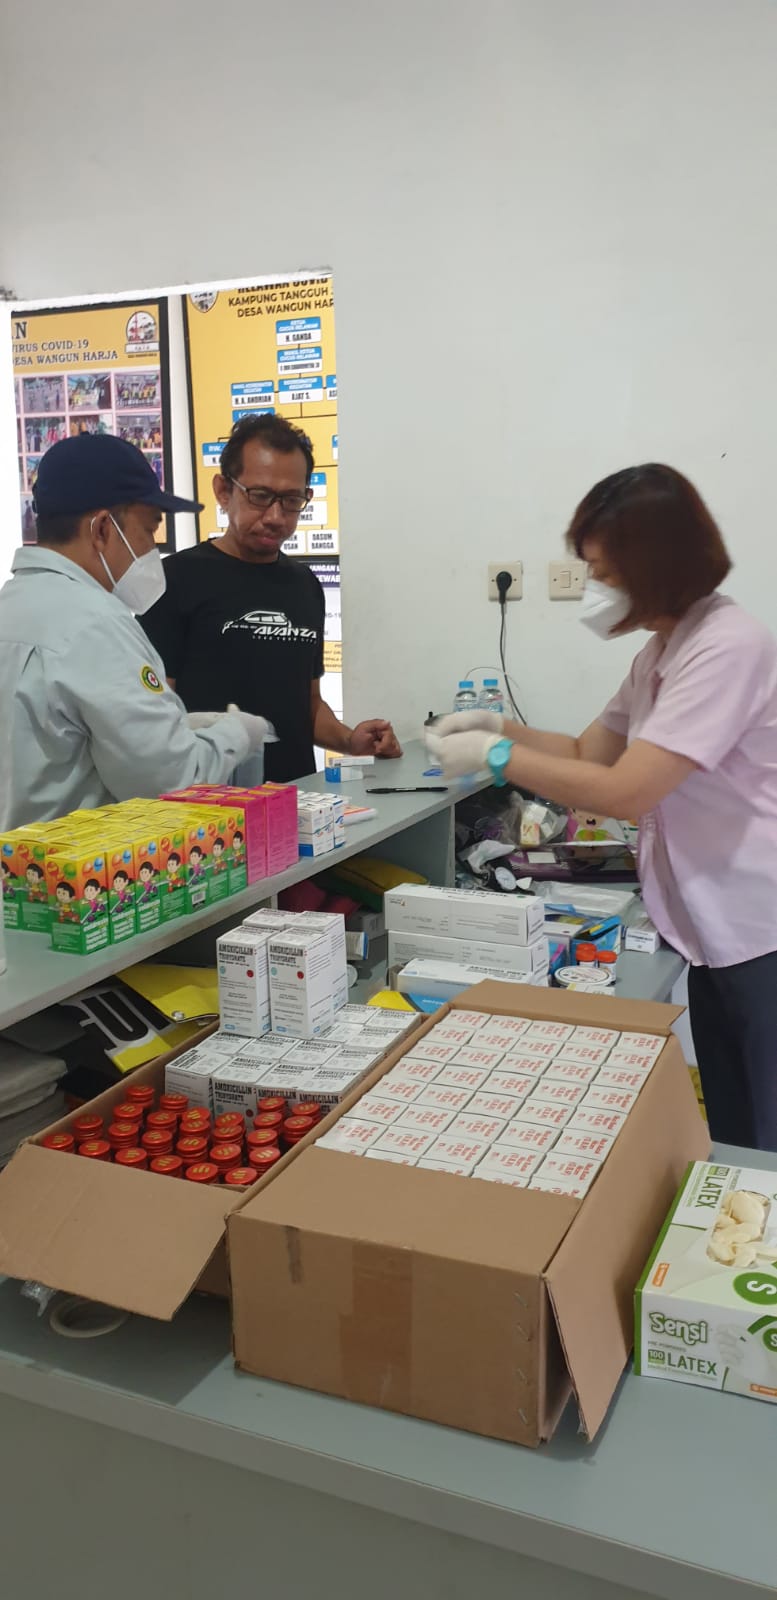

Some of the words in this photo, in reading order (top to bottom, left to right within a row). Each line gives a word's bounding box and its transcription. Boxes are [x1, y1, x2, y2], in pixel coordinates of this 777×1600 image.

[228, 292, 277, 307] KAMPUNG
[280, 286, 329, 301] TANGGUH
[237, 306, 263, 318] DESA
[265, 301, 311, 315] WANGUN
[12, 321, 27, 339] N
[36, 352, 79, 364] WANGUN
[83, 349, 118, 361] HARJA
[253, 625, 317, 639] AVANZA
[214, 1082, 252, 1095] AMOXICILLIN
[695, 1175, 726, 1209] LATEX
[648, 1311, 709, 1347] Sensi
[648, 1350, 664, 1360] 100
[667, 1352, 717, 1376] LATEX
